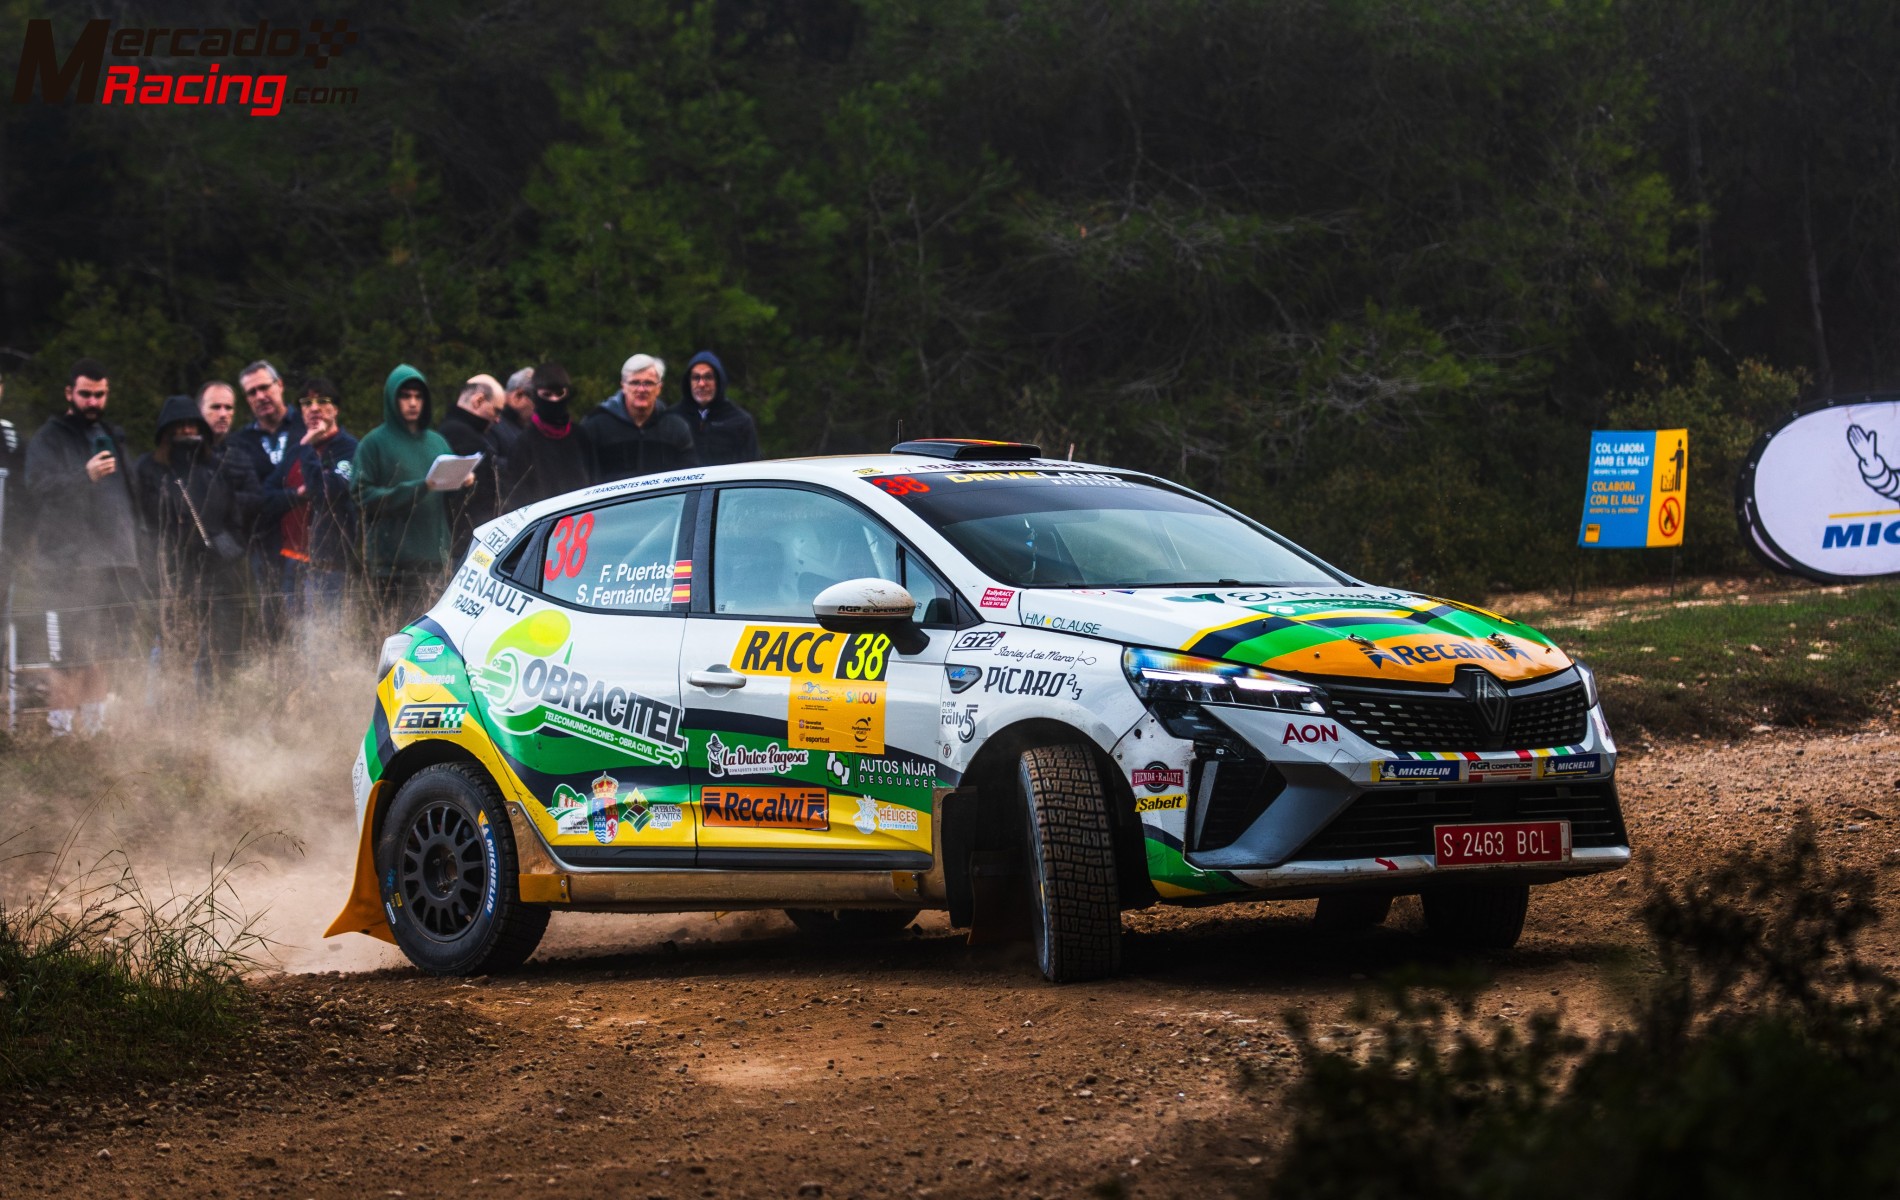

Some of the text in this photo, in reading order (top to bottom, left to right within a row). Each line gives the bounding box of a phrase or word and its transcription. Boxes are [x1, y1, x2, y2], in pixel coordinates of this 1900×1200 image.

[1627, 455, 1649, 467] RALLY
[872, 475, 931, 496] 38
[945, 471, 1123, 484] DRIVELAND
[1622, 494, 1645, 505] RALLY
[544, 512, 595, 581] 38
[600, 562, 674, 583] F. Puertas
[456, 564, 534, 616] RENAULT
[576, 584, 671, 605] S. Fernández
[1024, 612, 1102, 635] HM CLAUSE
[741, 630, 836, 674] RACC
[846, 633, 891, 680] 38
[1390, 642, 1507, 666] Recalvi
[521, 658, 690, 749] OBRACITEL
[846, 691, 876, 705] SALOU
[941, 712, 965, 728] rally
[544, 710, 614, 742] TELECOMUNICACIONES
[619, 736, 637, 750] OBRA
[637, 742, 653, 755] CIVIL
[1283, 723, 1338, 744] AON
[723, 749, 736, 766] La
[737, 747, 767, 765] Dulce
[1557, 760, 1595, 771] MICHELIN
[860, 759, 936, 777] AUTOS NÍJAR
[1398, 767, 1451, 776] MICHELIN
[860, 774, 936, 789] DESGUACES
[724, 793, 805, 823] Recalvi
[879, 805, 917, 823] HÉLICES
[1139, 796, 1183, 811] Sabelt
[1443, 830, 1550, 857] S 2463 BCL
[487, 839, 497, 913] MICHELIN
